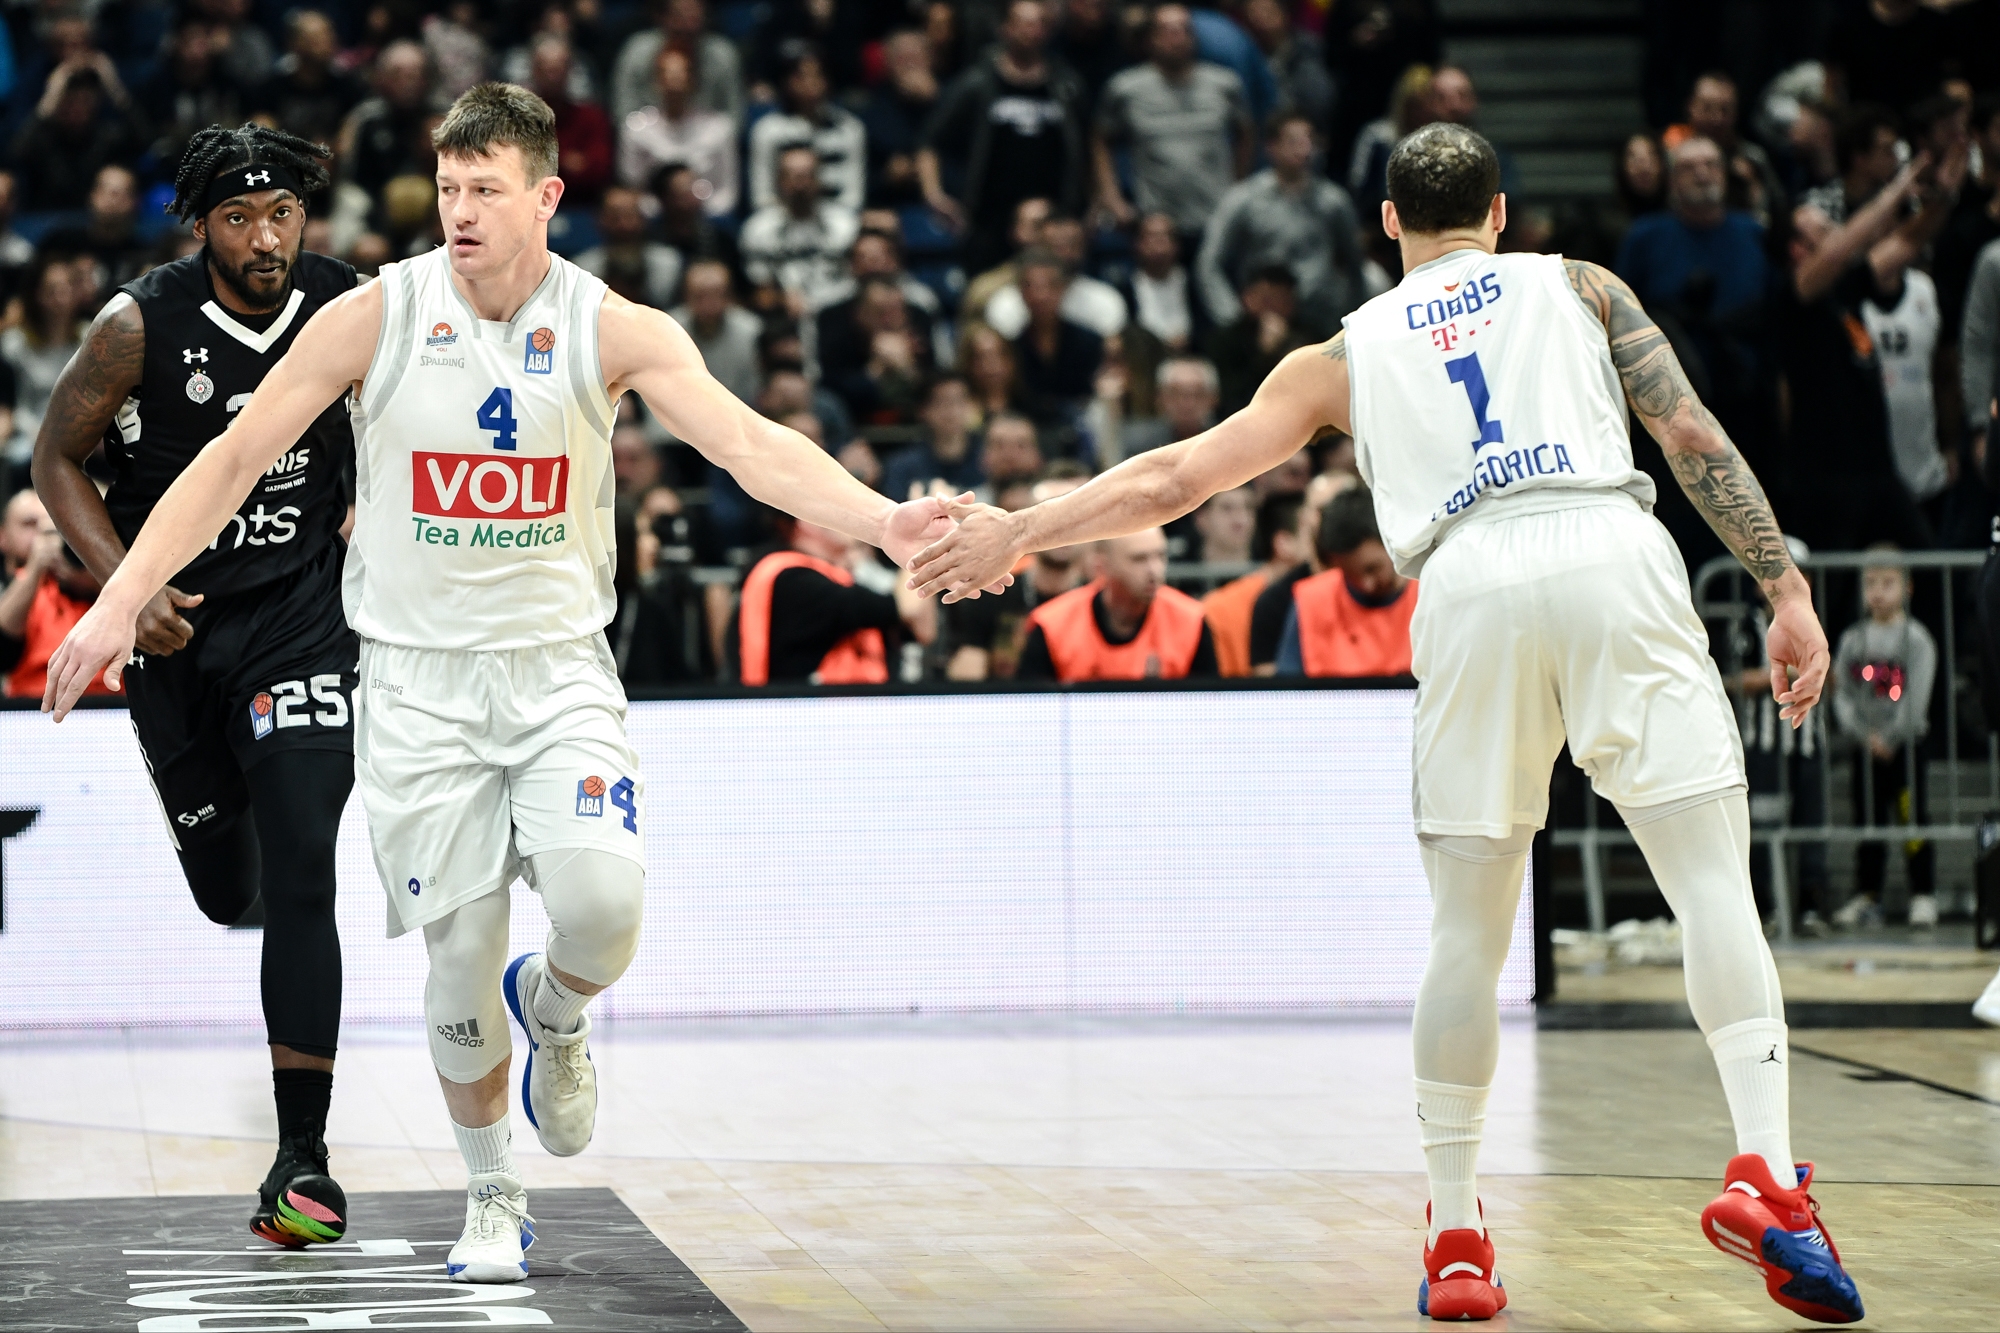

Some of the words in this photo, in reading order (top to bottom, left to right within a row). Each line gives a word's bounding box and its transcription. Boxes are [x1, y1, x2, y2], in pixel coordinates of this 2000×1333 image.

[1406, 272, 1502, 330] COBBS
[420, 355, 465, 369] SPALDING
[527, 353, 550, 372] ABA
[1444, 351, 1504, 455] 1
[476, 386, 517, 451] 4
[264, 481, 294, 493] GAZPROM
[293, 476, 306, 487] NEFT
[426, 458, 561, 513] VOLI
[412, 517, 460, 546] Tea
[470, 522, 566, 548] Medica
[271, 674, 349, 729] 25
[255, 715, 271, 737] ABA
[197, 803, 215, 817] NIS
[578, 797, 600, 815] ABA
[609, 776, 638, 836] 4
[436, 1025, 485, 1048] adidas
